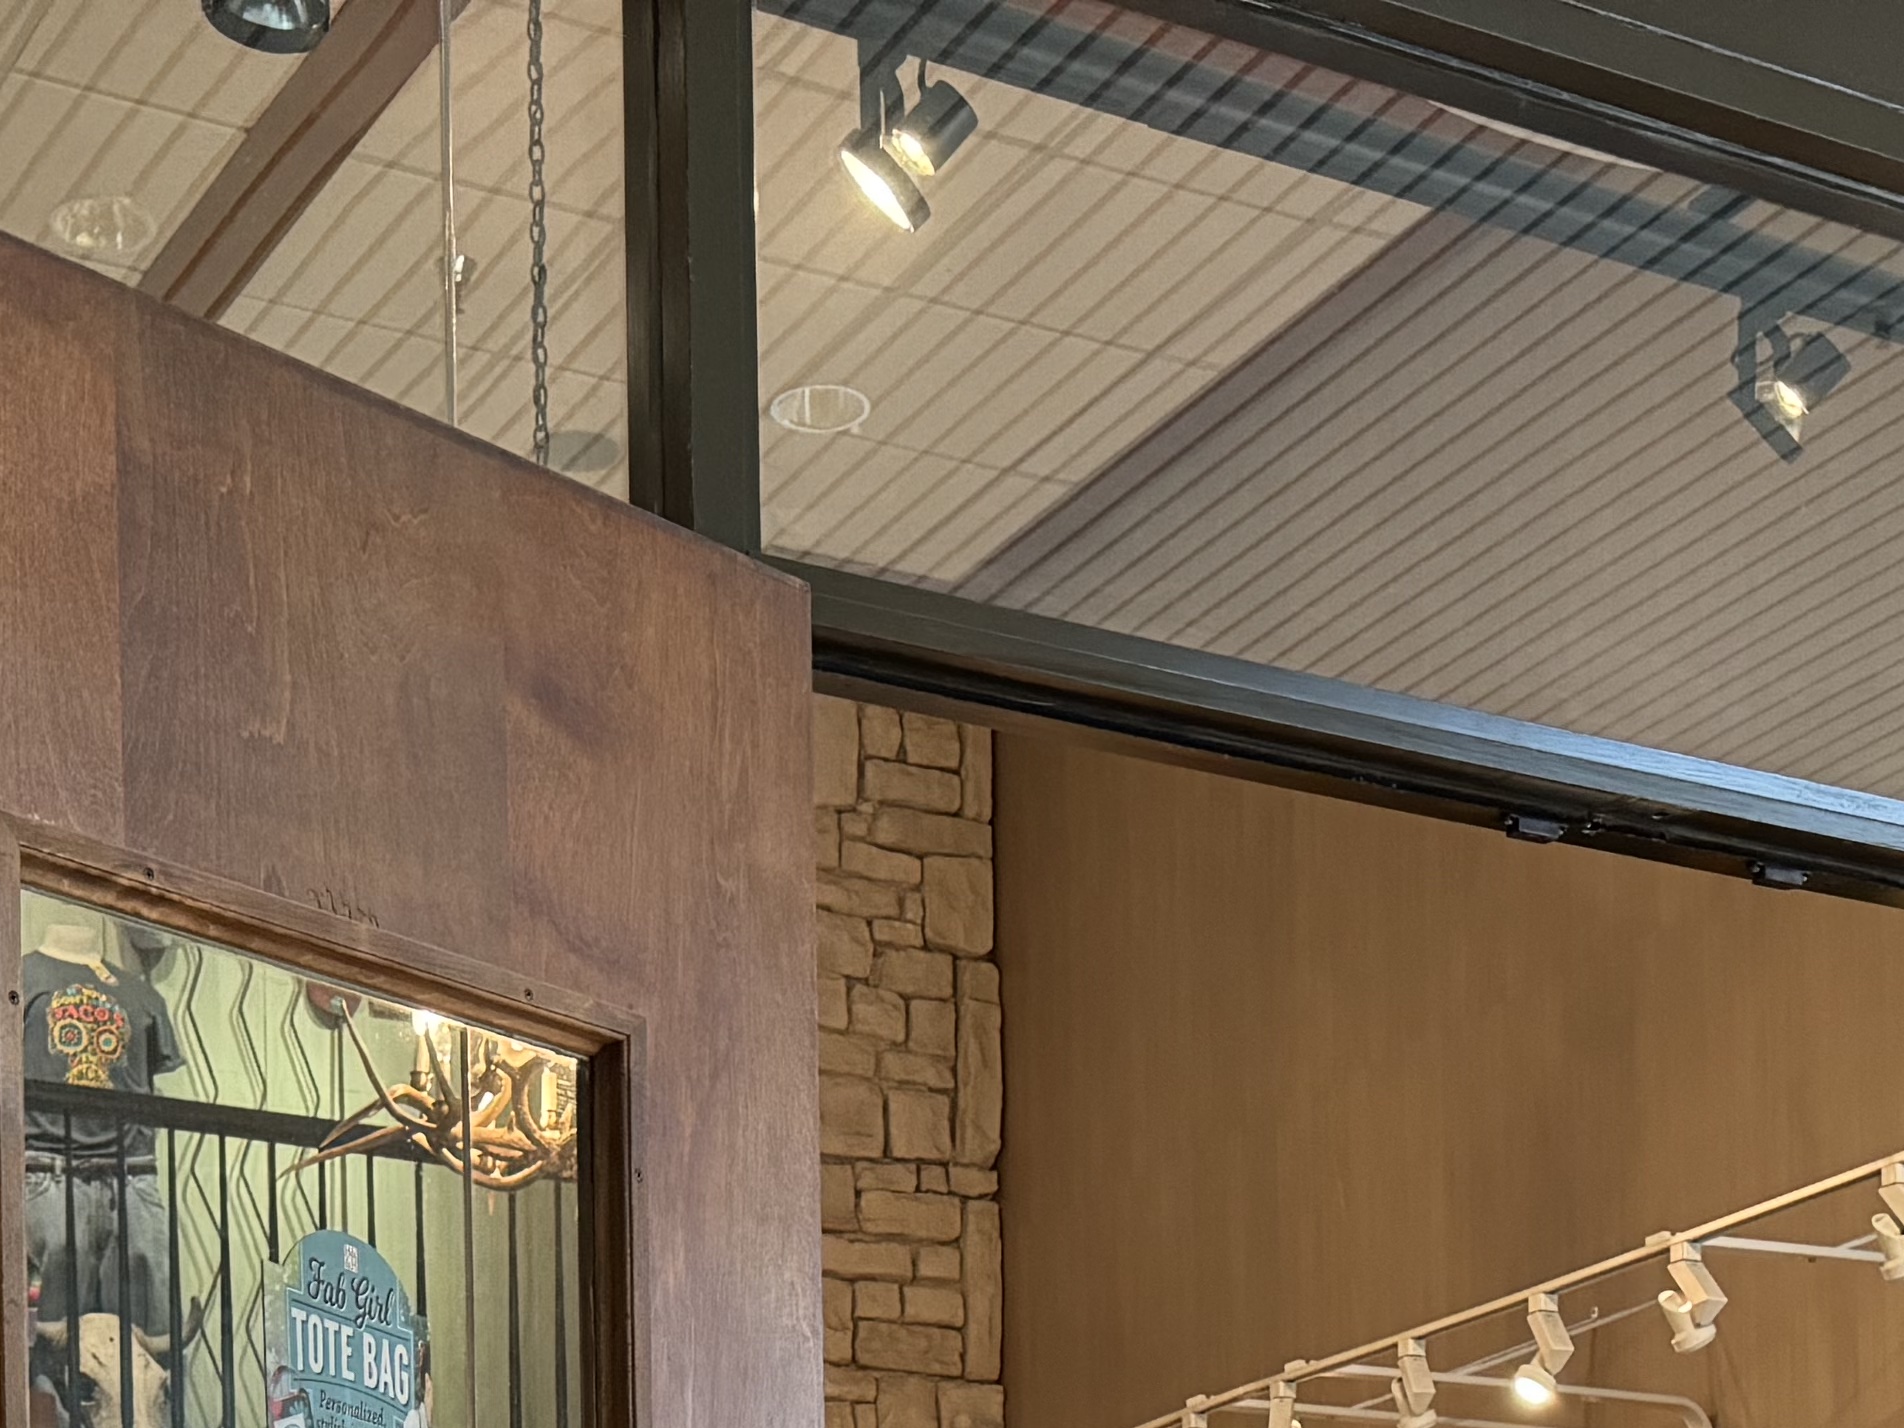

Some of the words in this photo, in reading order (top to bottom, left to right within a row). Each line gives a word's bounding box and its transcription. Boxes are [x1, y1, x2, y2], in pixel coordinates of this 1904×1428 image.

[307, 1256, 346, 1311] Fab
[351, 1275, 395, 1329] Girl
[290, 1305, 356, 1383] TOTE
[361, 1332, 411, 1407] BAG
